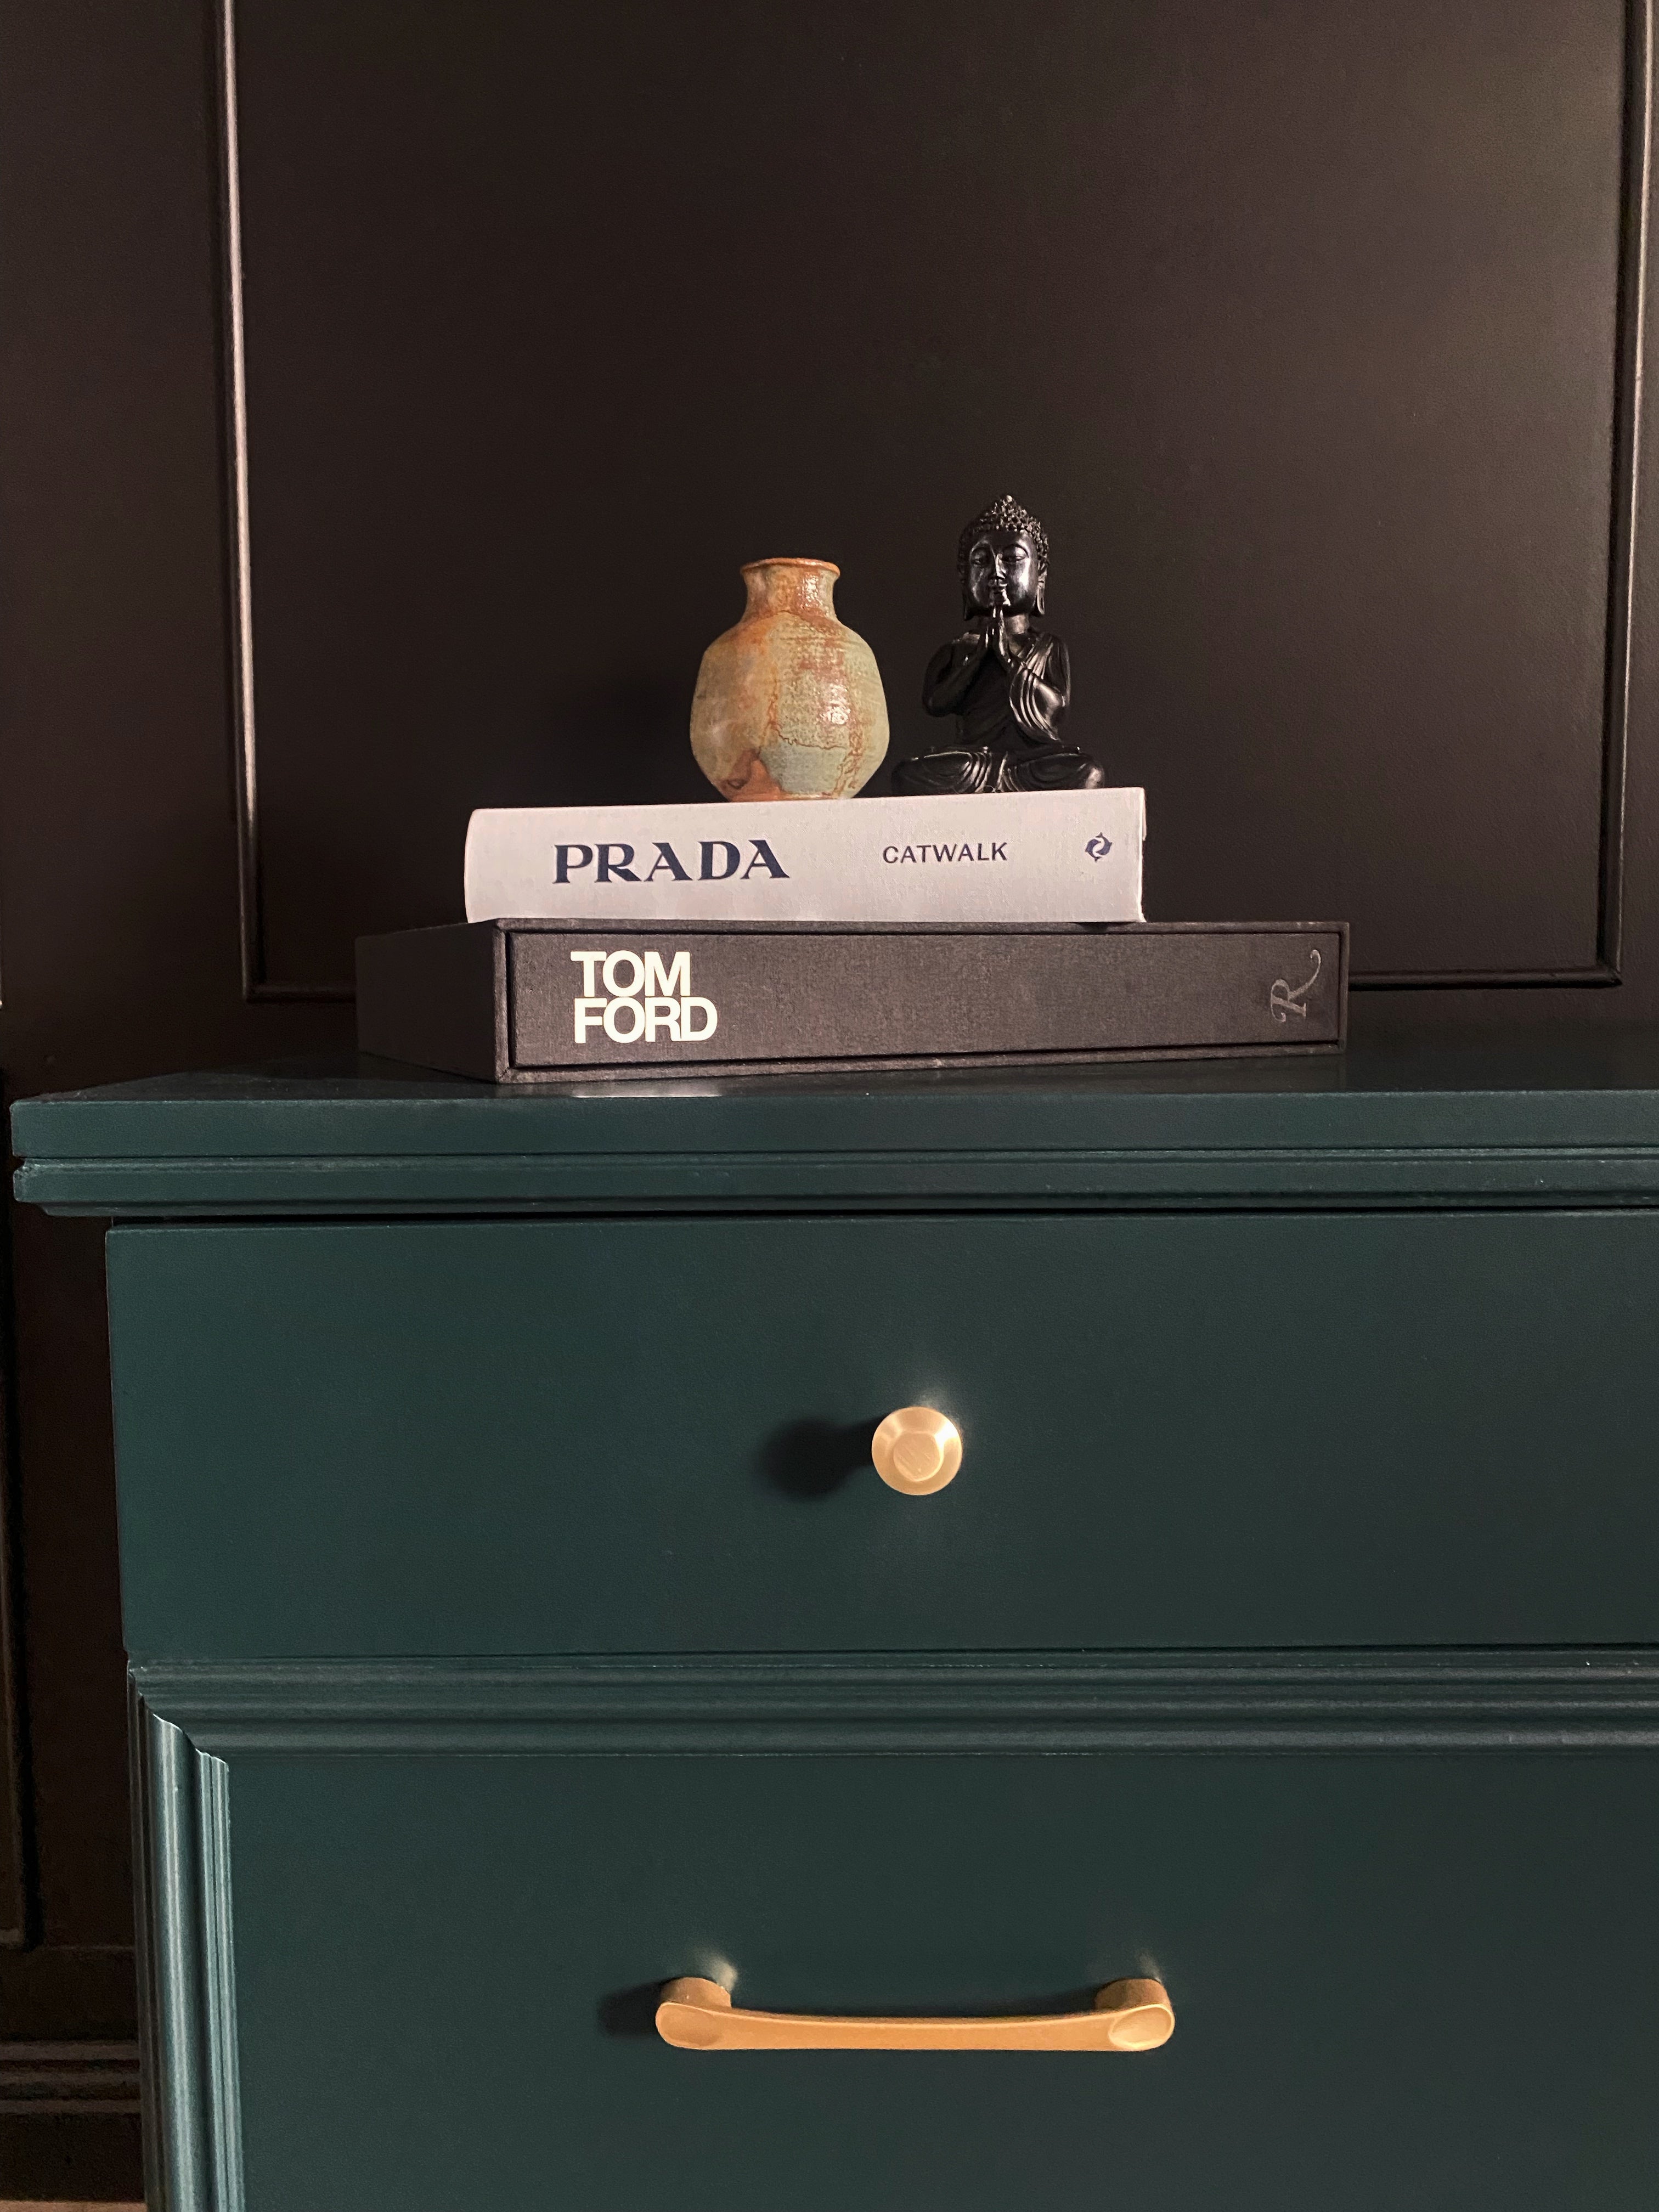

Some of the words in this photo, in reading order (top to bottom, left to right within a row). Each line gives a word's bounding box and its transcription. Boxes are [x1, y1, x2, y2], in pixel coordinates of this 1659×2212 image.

[552, 840, 790, 884] PRADA
[883, 842, 1008, 864] CATWALK
[571, 950, 690, 997] TOM
[574, 996, 718, 1043] FORD
